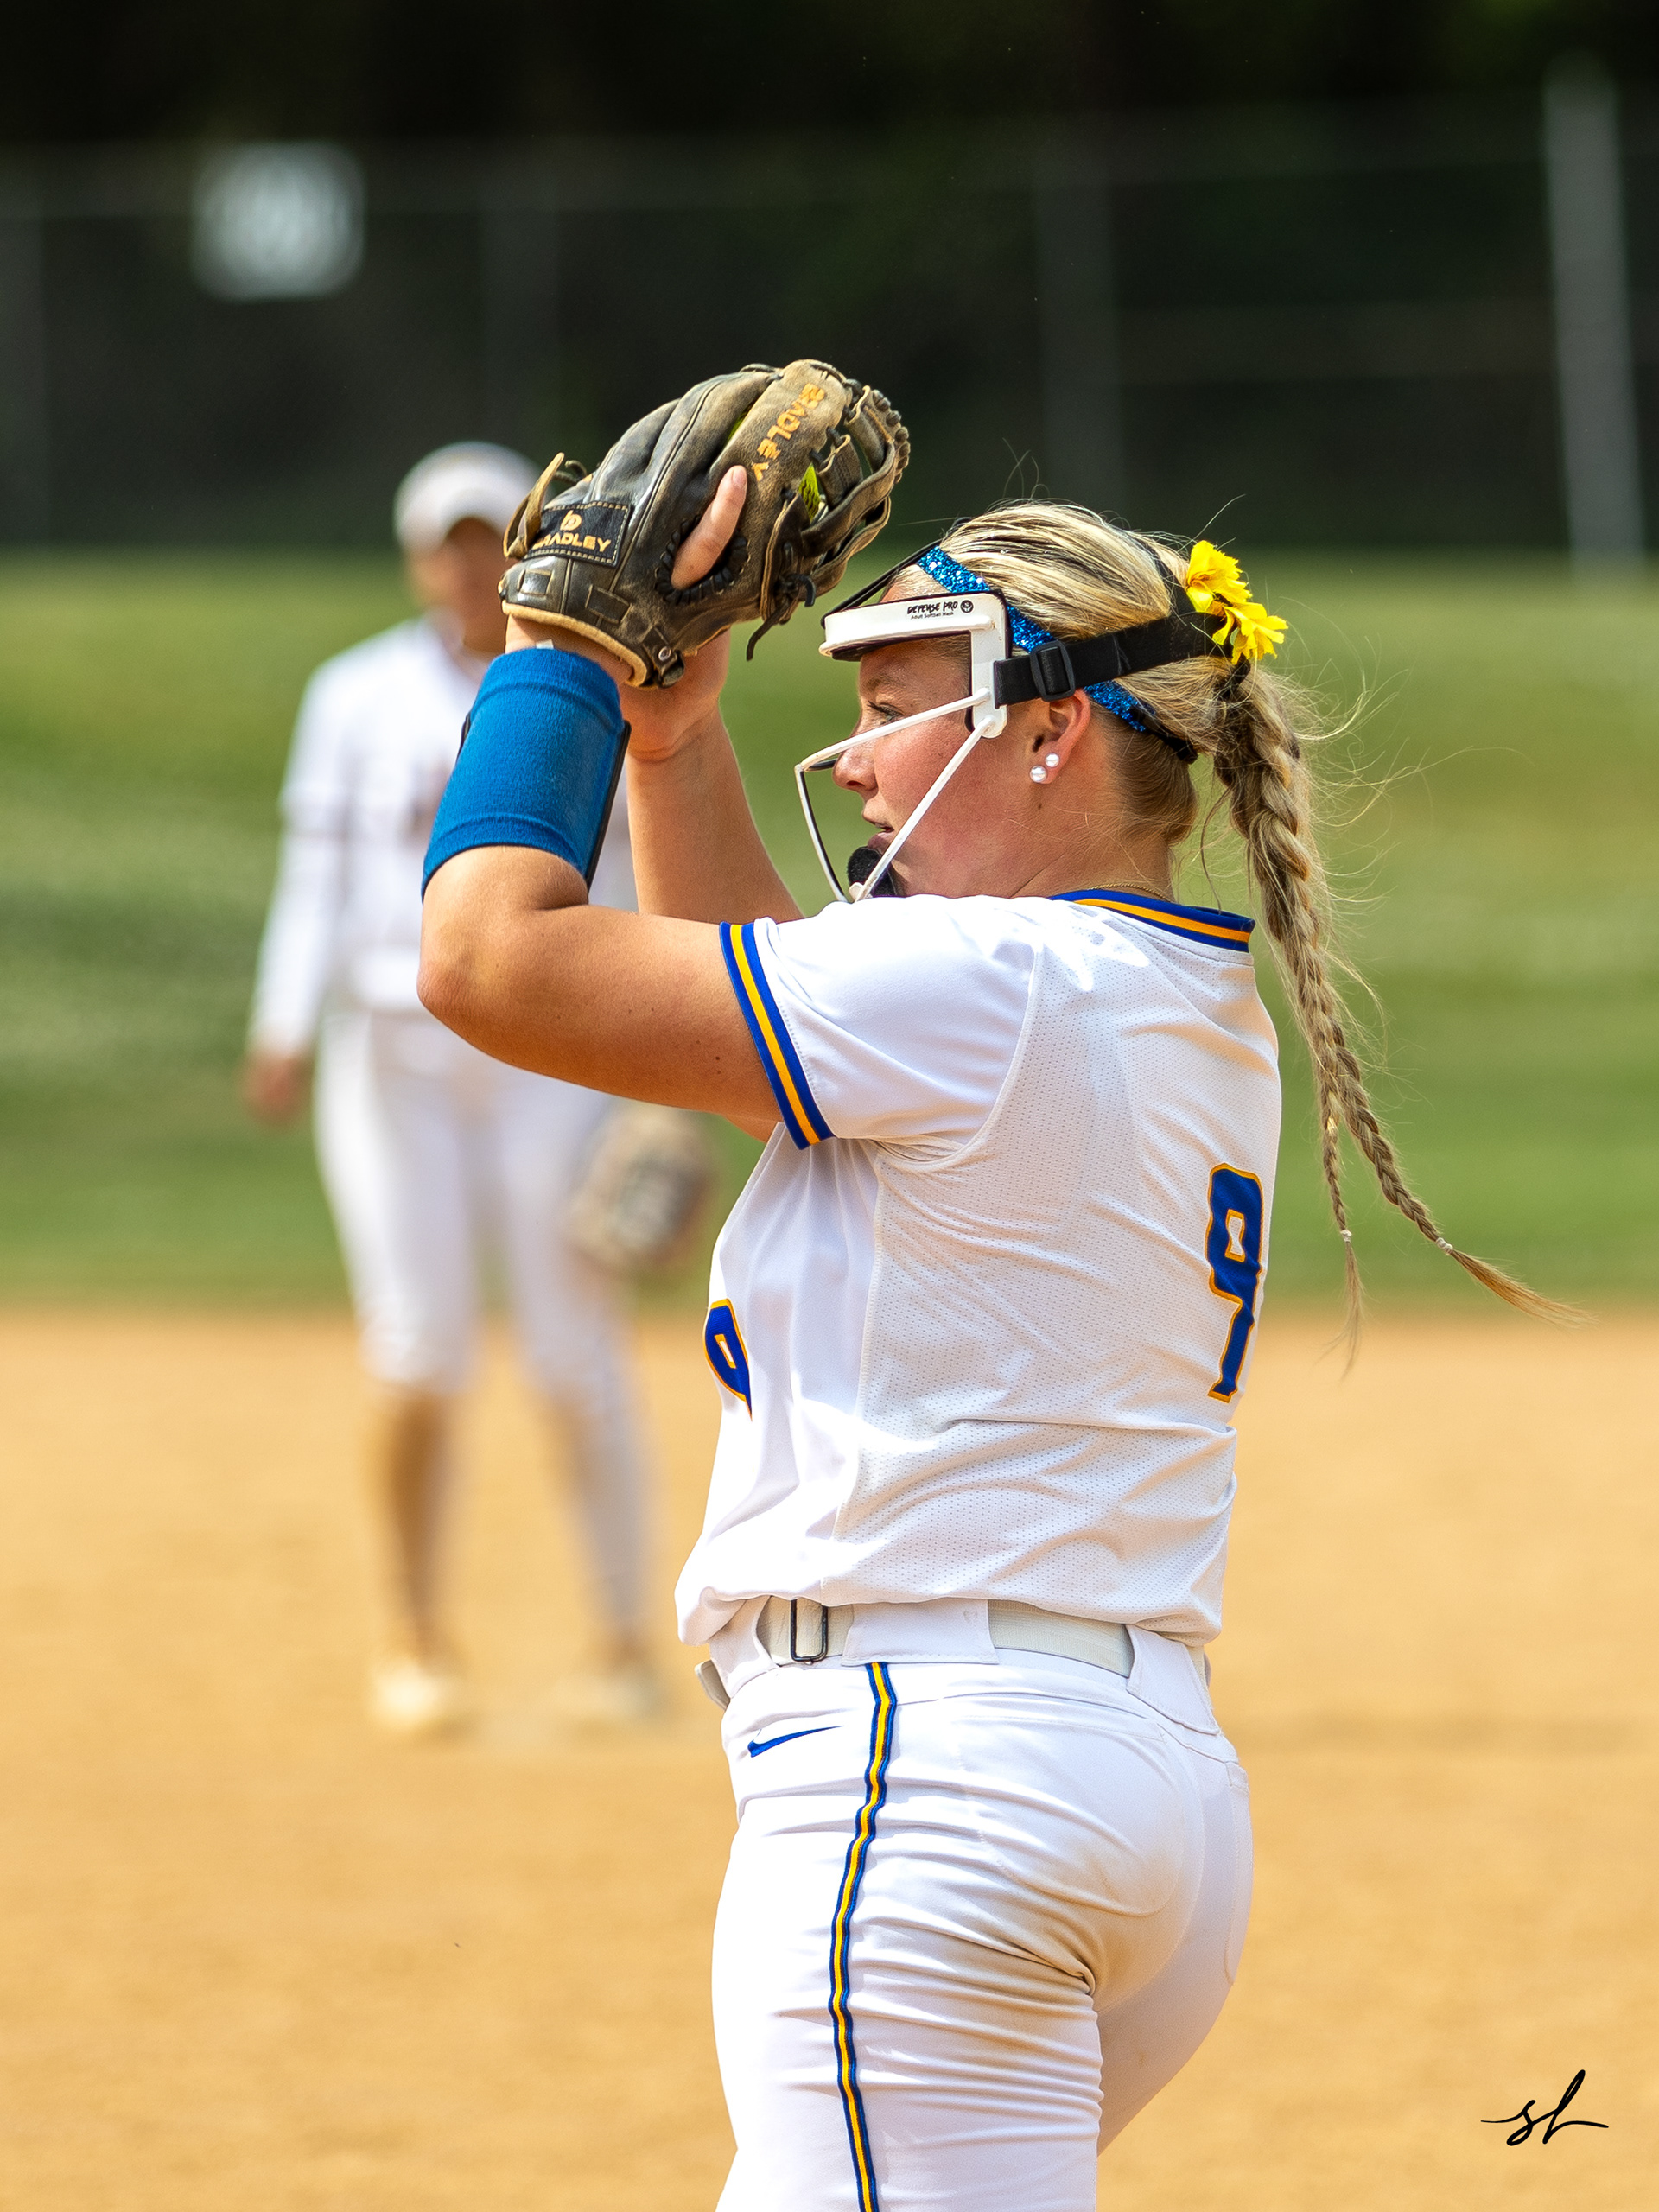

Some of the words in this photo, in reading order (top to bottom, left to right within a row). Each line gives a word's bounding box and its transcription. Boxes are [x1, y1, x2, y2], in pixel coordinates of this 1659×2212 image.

[751, 383, 825, 482] BRADLEY
[907, 602, 941, 614] DEFENSE
[943, 601, 958, 612] PRO
[1205, 1162, 1263, 1403] 9
